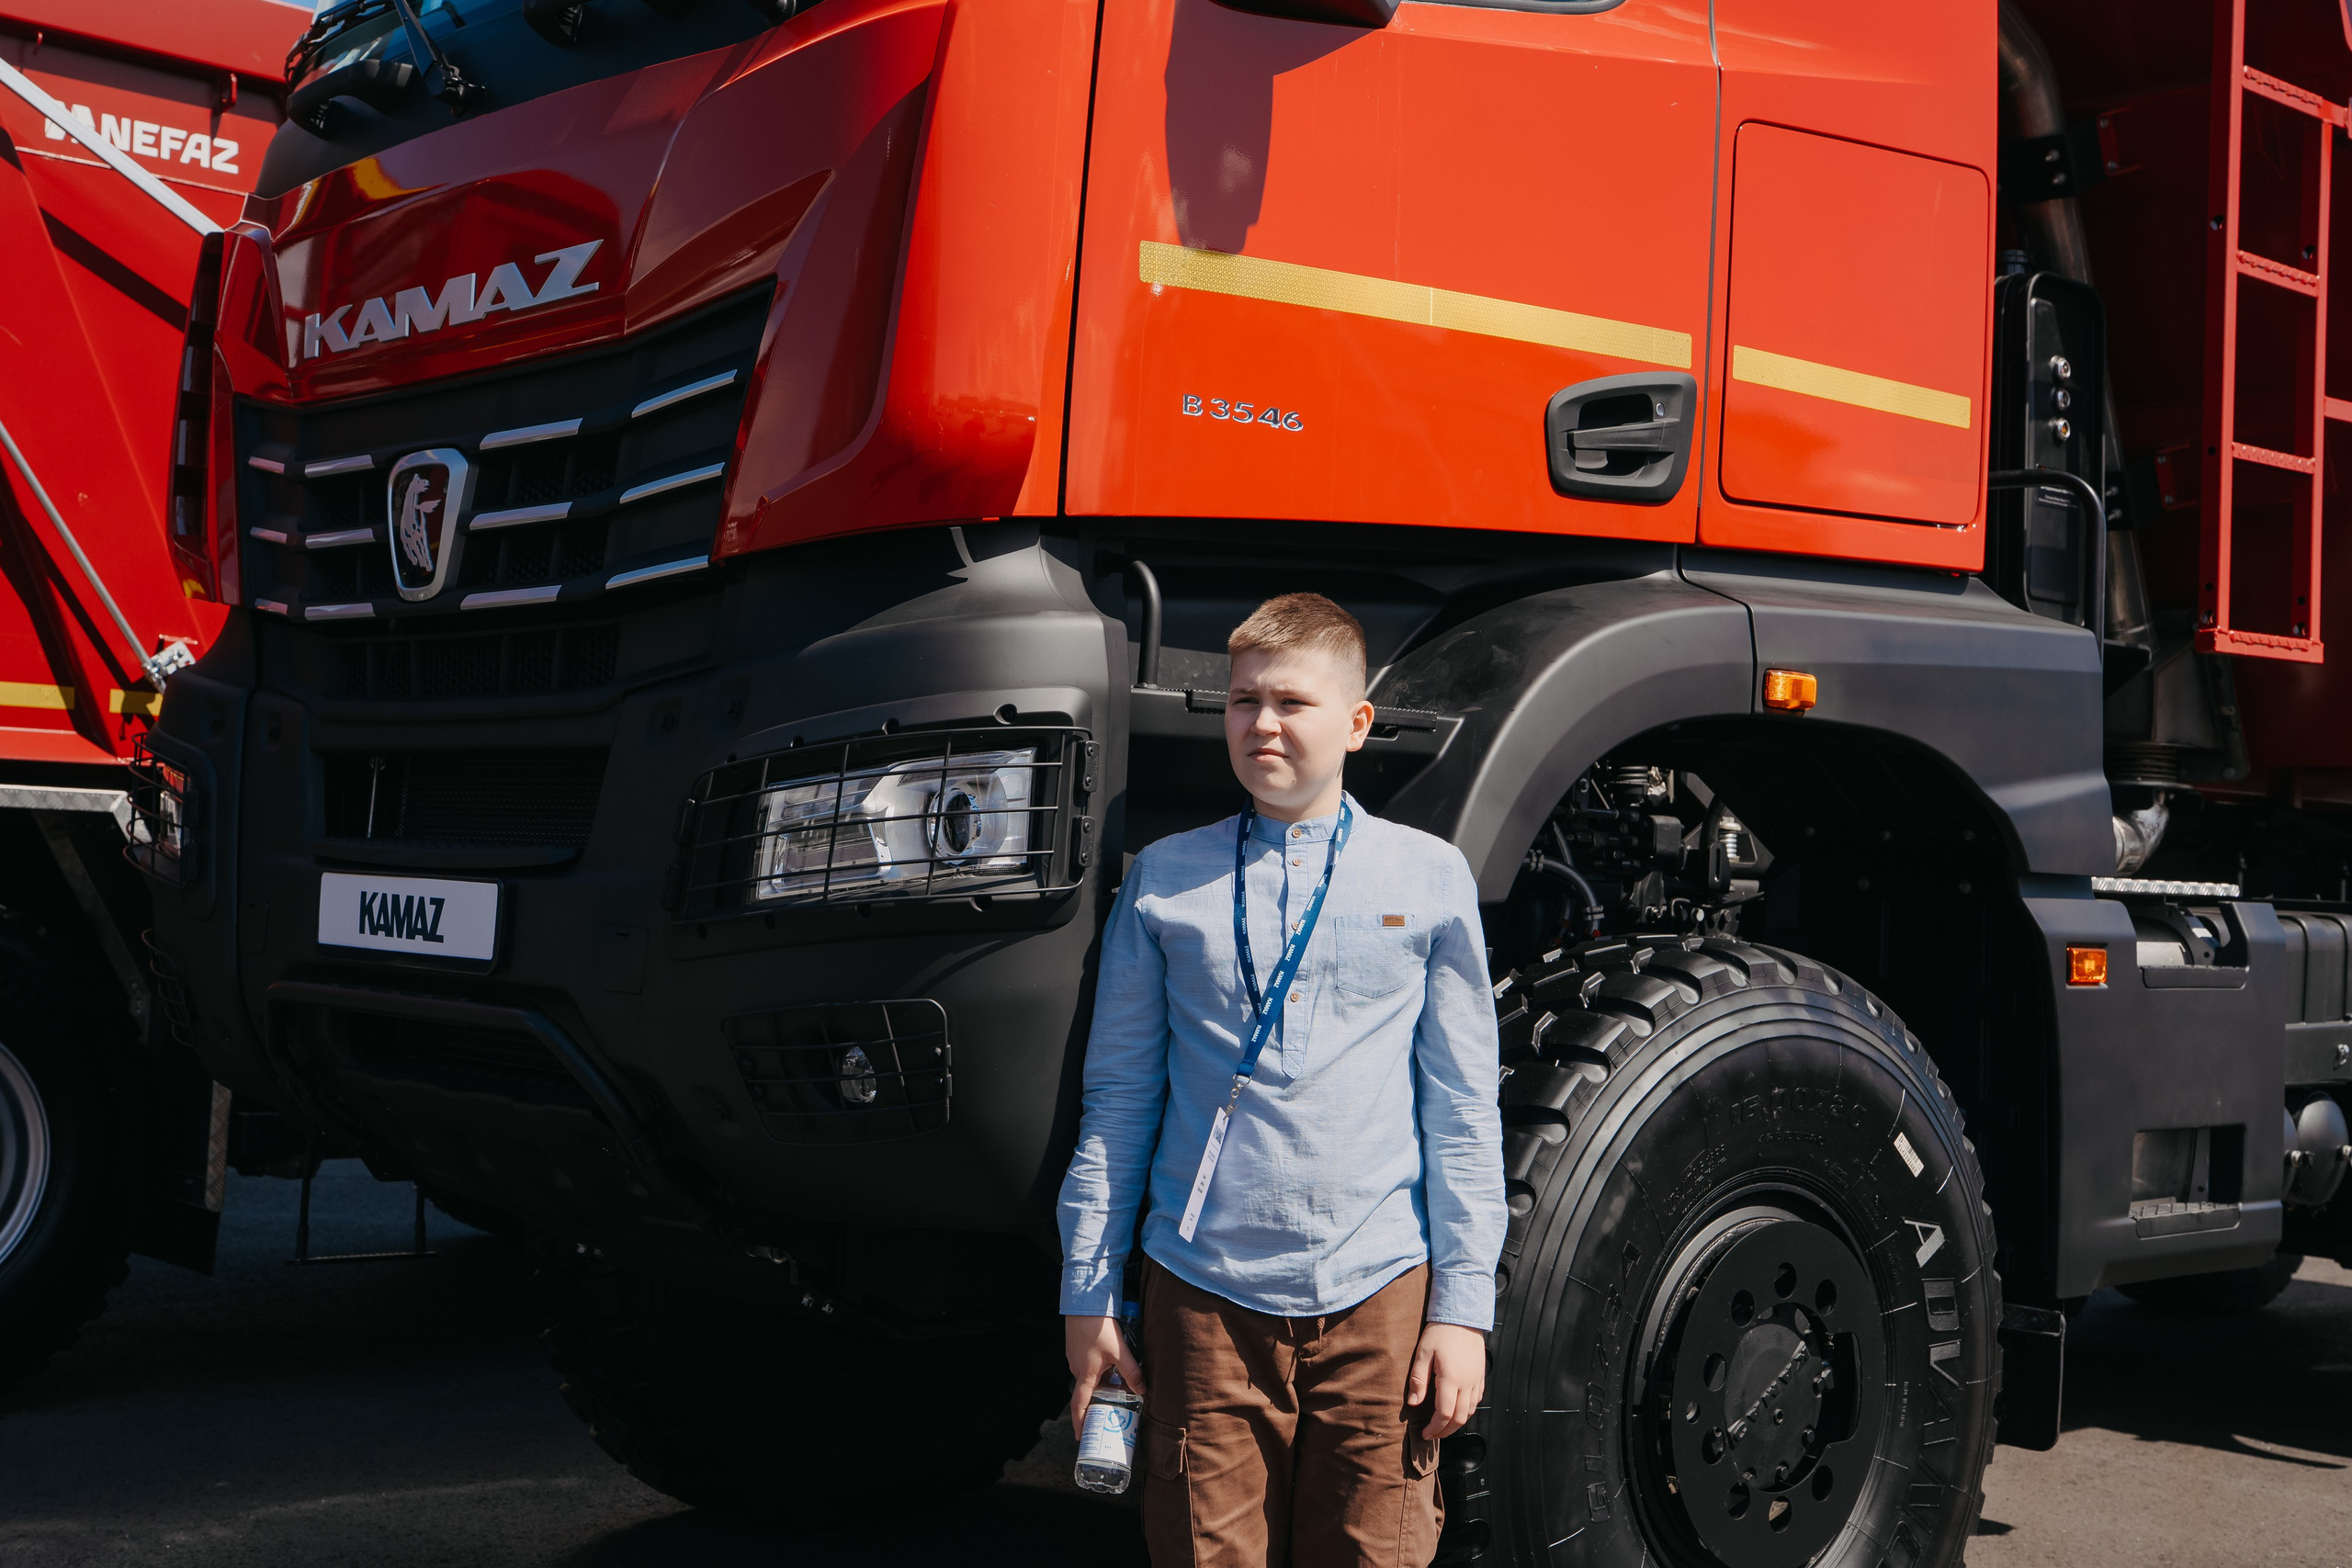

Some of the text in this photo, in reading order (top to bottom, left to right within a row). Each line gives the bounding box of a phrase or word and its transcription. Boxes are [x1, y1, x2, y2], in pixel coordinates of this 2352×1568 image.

[101, 113, 239, 175] NEFAZ
[304, 239, 604, 359] KAMAZ
[1306, 896, 1317, 911] KAMAZ
[359, 890, 446, 943] KAMAZ
[1295, 919, 1306, 936] KAMAZ
[1284, 943, 1296, 962] KAMAZ
[1273, 970, 1284, 988] KAMAZ
[1261, 997, 1273, 1015] KAMAZ
[1250, 1024, 1262, 1043] KAMAZ
